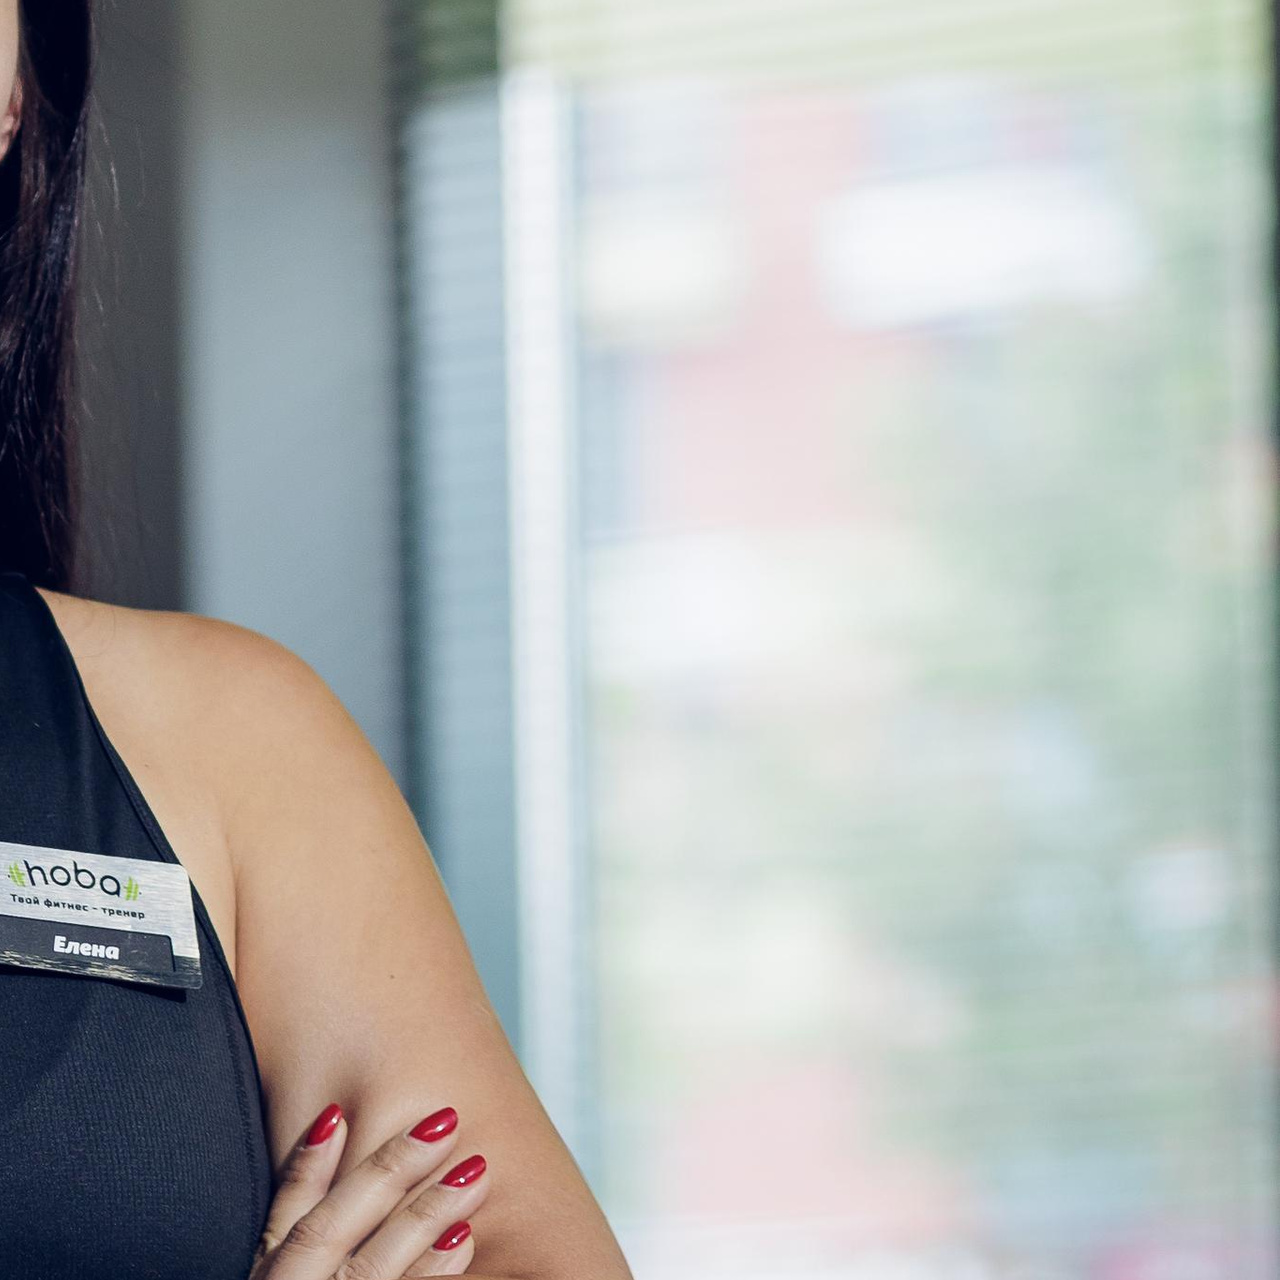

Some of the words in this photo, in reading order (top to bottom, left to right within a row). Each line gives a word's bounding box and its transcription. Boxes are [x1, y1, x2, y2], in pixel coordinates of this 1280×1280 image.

[23, 859, 120, 898] hoba
[10, 893, 40, 905] Твой
[43, 898, 89, 912] фитнес
[101, 907, 146, 920] тренер
[53, 934, 120, 961] Елена
